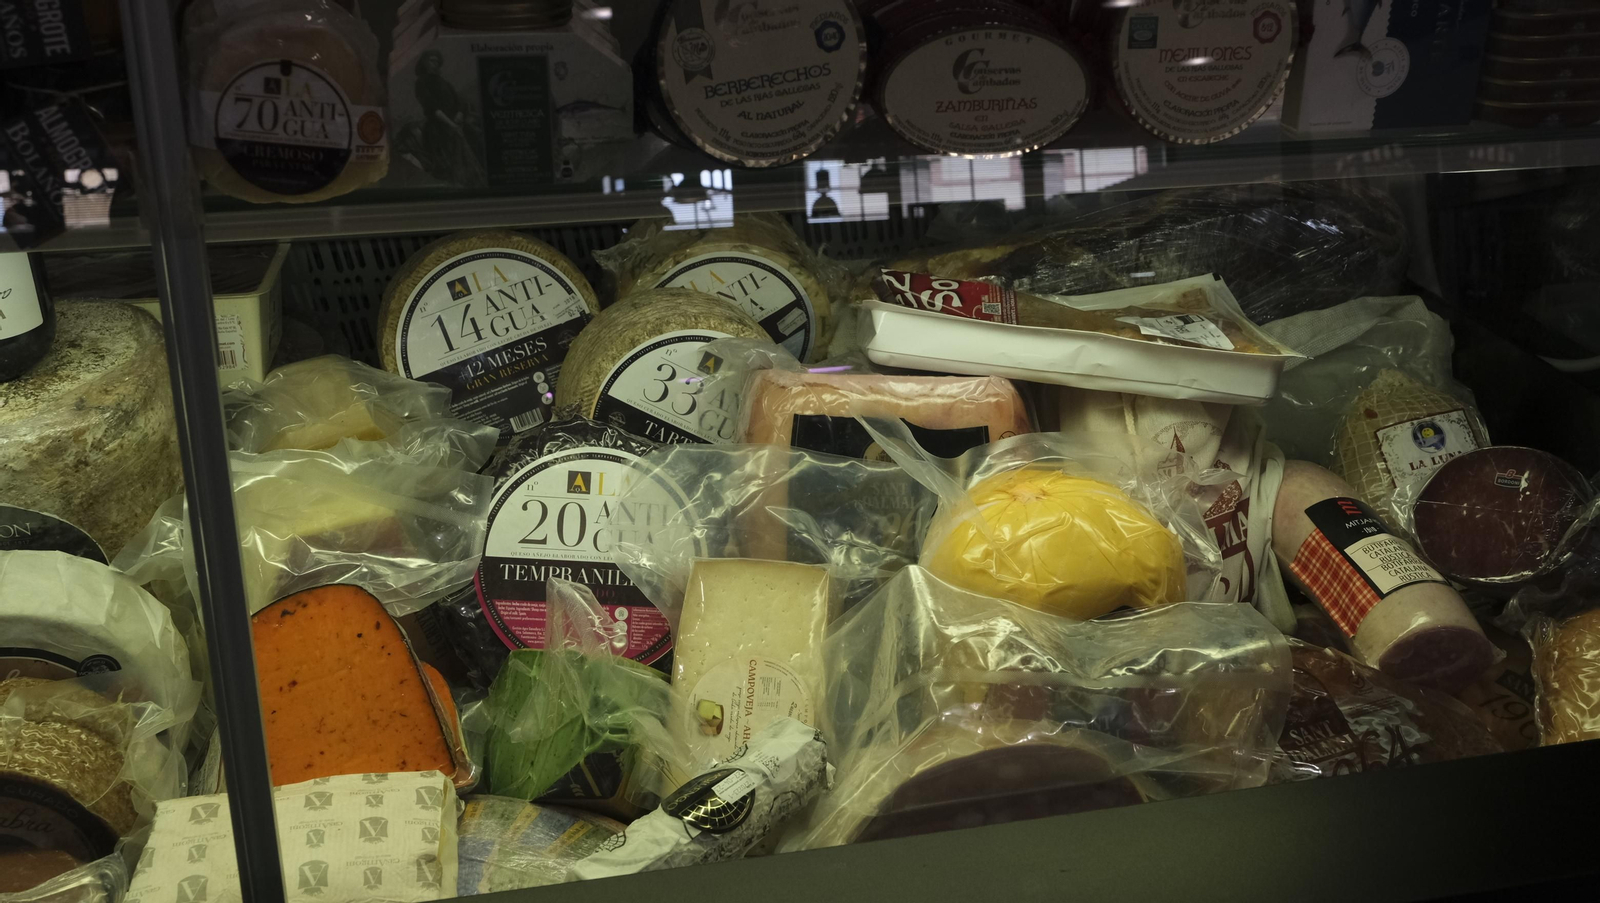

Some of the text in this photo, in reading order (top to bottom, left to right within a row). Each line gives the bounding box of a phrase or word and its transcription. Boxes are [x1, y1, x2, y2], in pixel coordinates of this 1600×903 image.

[809, 11, 849, 30] MEDIANOS
[470, 43, 554, 54] Elaboración propia
[945, 32, 1033, 46] GOURMET
[704, 63, 832, 100] BERBERECHOS
[736, 95, 753, 106] LAS
[775, 83, 821, 98] GALLEGAS
[935, 97, 1038, 114] ZAMBURIÑAS
[234, 97, 279, 133] 70
[737, 100, 805, 121] AL NATURAL
[1213, 99, 1240, 116] PROPIA
[283, 119, 329, 140] GUA
[981, 118, 1026, 132] GALLEGA
[33, 104, 91, 171] ALMOGR
[242, 144, 324, 162] CREMOSO
[471, 264, 511, 293] LA
[485, 275, 553, 316] ANTI-
[430, 303, 487, 355] 14
[490, 304, 547, 338] GUA
[486, 336, 549, 370] MESES
[466, 353, 550, 391] GRAN RESERVA
[642, 363, 705, 417] 33
[643, 420, 698, 445] TART
[1409, 451, 1465, 473] LA LUN
[517, 499, 588, 548] 20
[1344, 518, 1381, 530] MITJAN
[1361, 538, 1401, 555] BUTIFARR
[500, 563, 637, 587] TEMPRANIL
[1380, 558, 1426, 572] BOTIFARRA
[1388, 564, 1431, 577] CATALANA
[1506, 673, 1535, 702] SAN
[742, 659, 758, 745] CAMPOVEJA AH
[1289, 719, 1339, 746] SANT
[4, 785, 79, 819] CURADO
